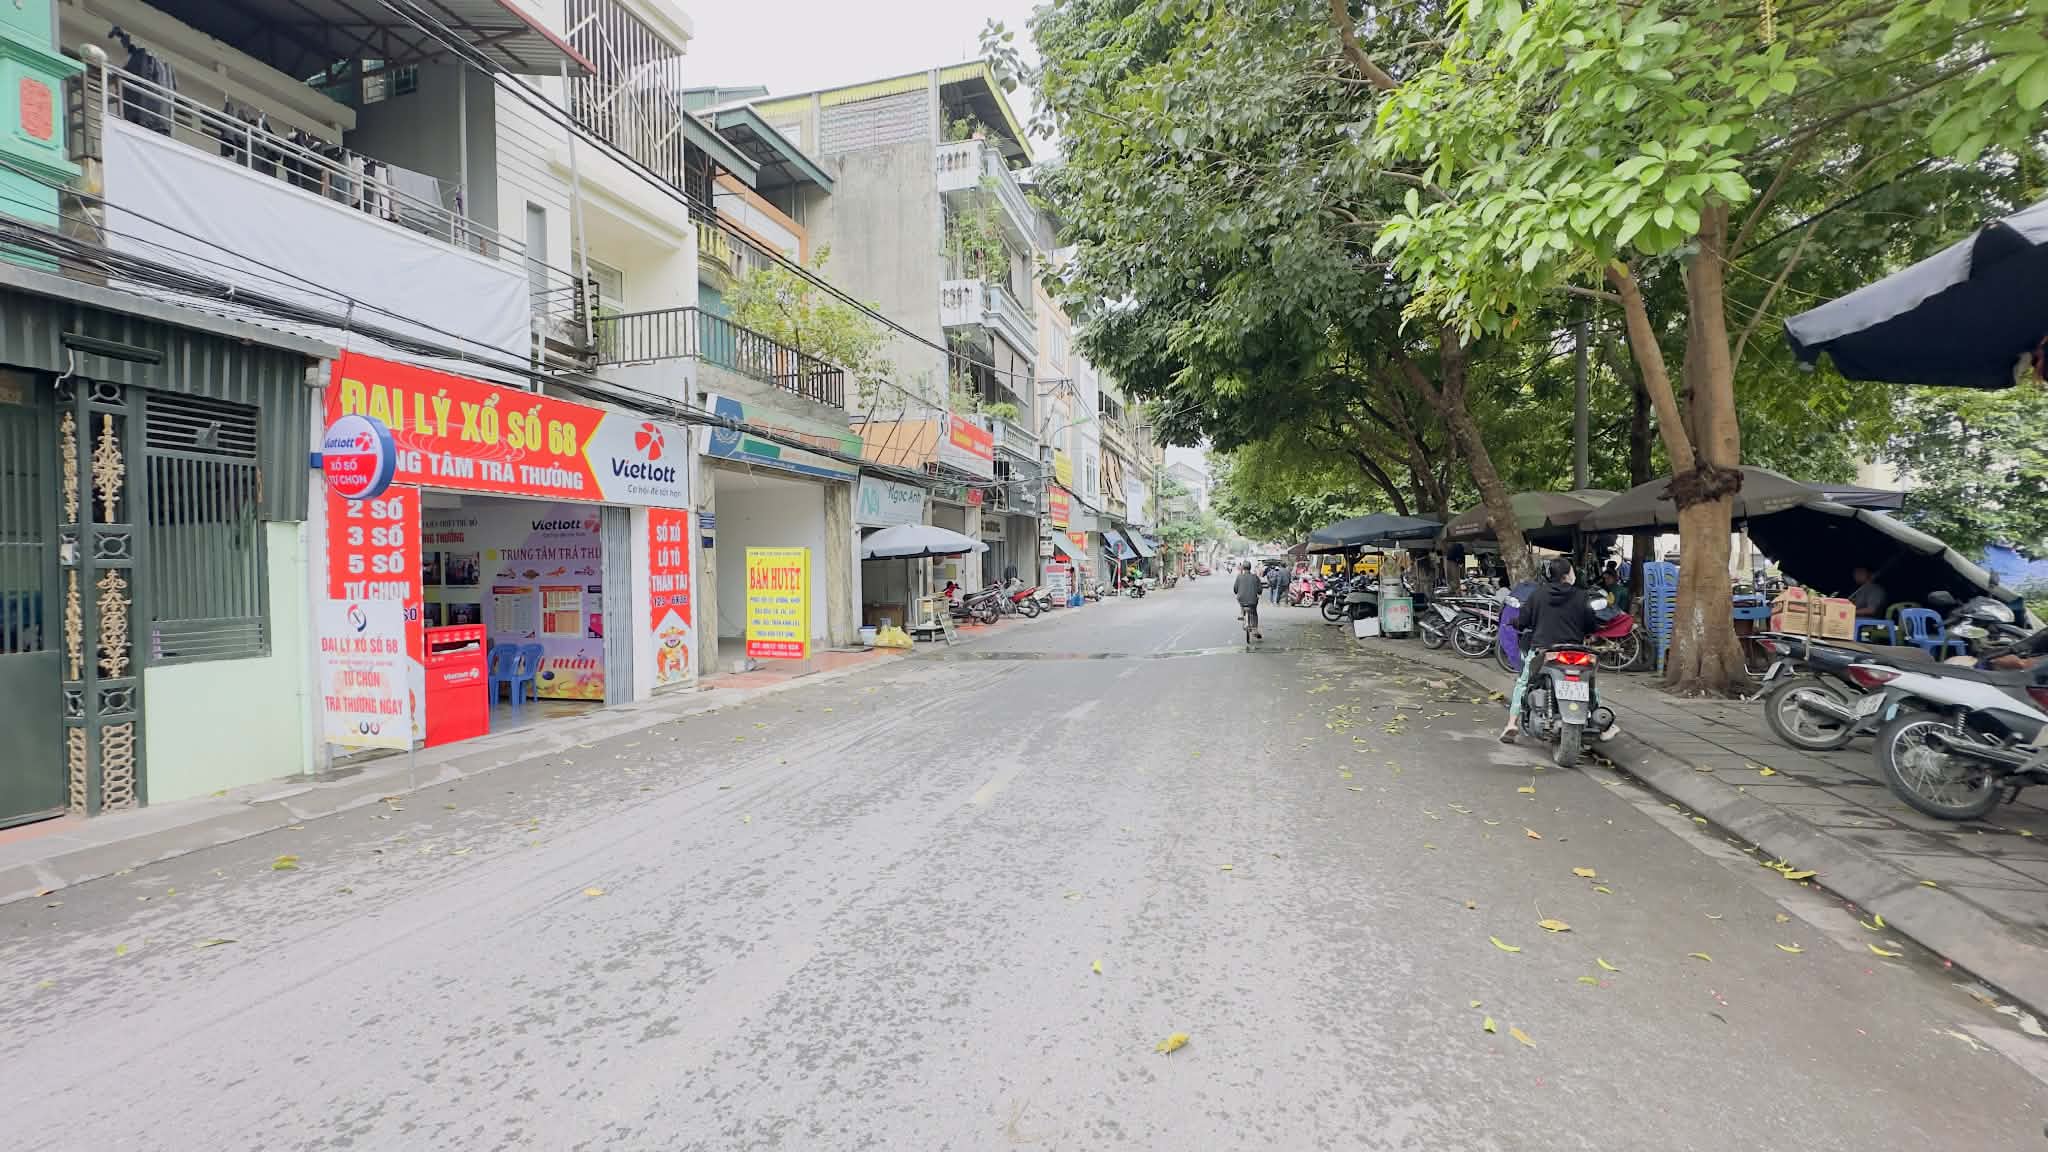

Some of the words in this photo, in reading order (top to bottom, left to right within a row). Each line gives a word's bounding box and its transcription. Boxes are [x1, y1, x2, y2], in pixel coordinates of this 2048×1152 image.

[414, 388, 452, 438] LÝ
[460, 392, 500, 446] XỔ
[507, 403, 543, 452] SỐ
[547, 419, 577, 457] 68
[427, 450, 474, 479] TÂM
[479, 454, 516, 484] TRẢ
[519, 461, 584, 491] THƯỞNG
[611, 456, 676, 483] Vietlott
[347, 500, 364, 518] 2
[370, 495, 405, 520] SỐ
[347, 525, 364, 547] 3
[371, 521, 406, 548] SỐ
[531, 519, 582, 531] Vietlott
[348, 553, 365, 574] 5
[371, 548, 406, 574] SỐ
[499, 547, 534, 561] TRUNG
